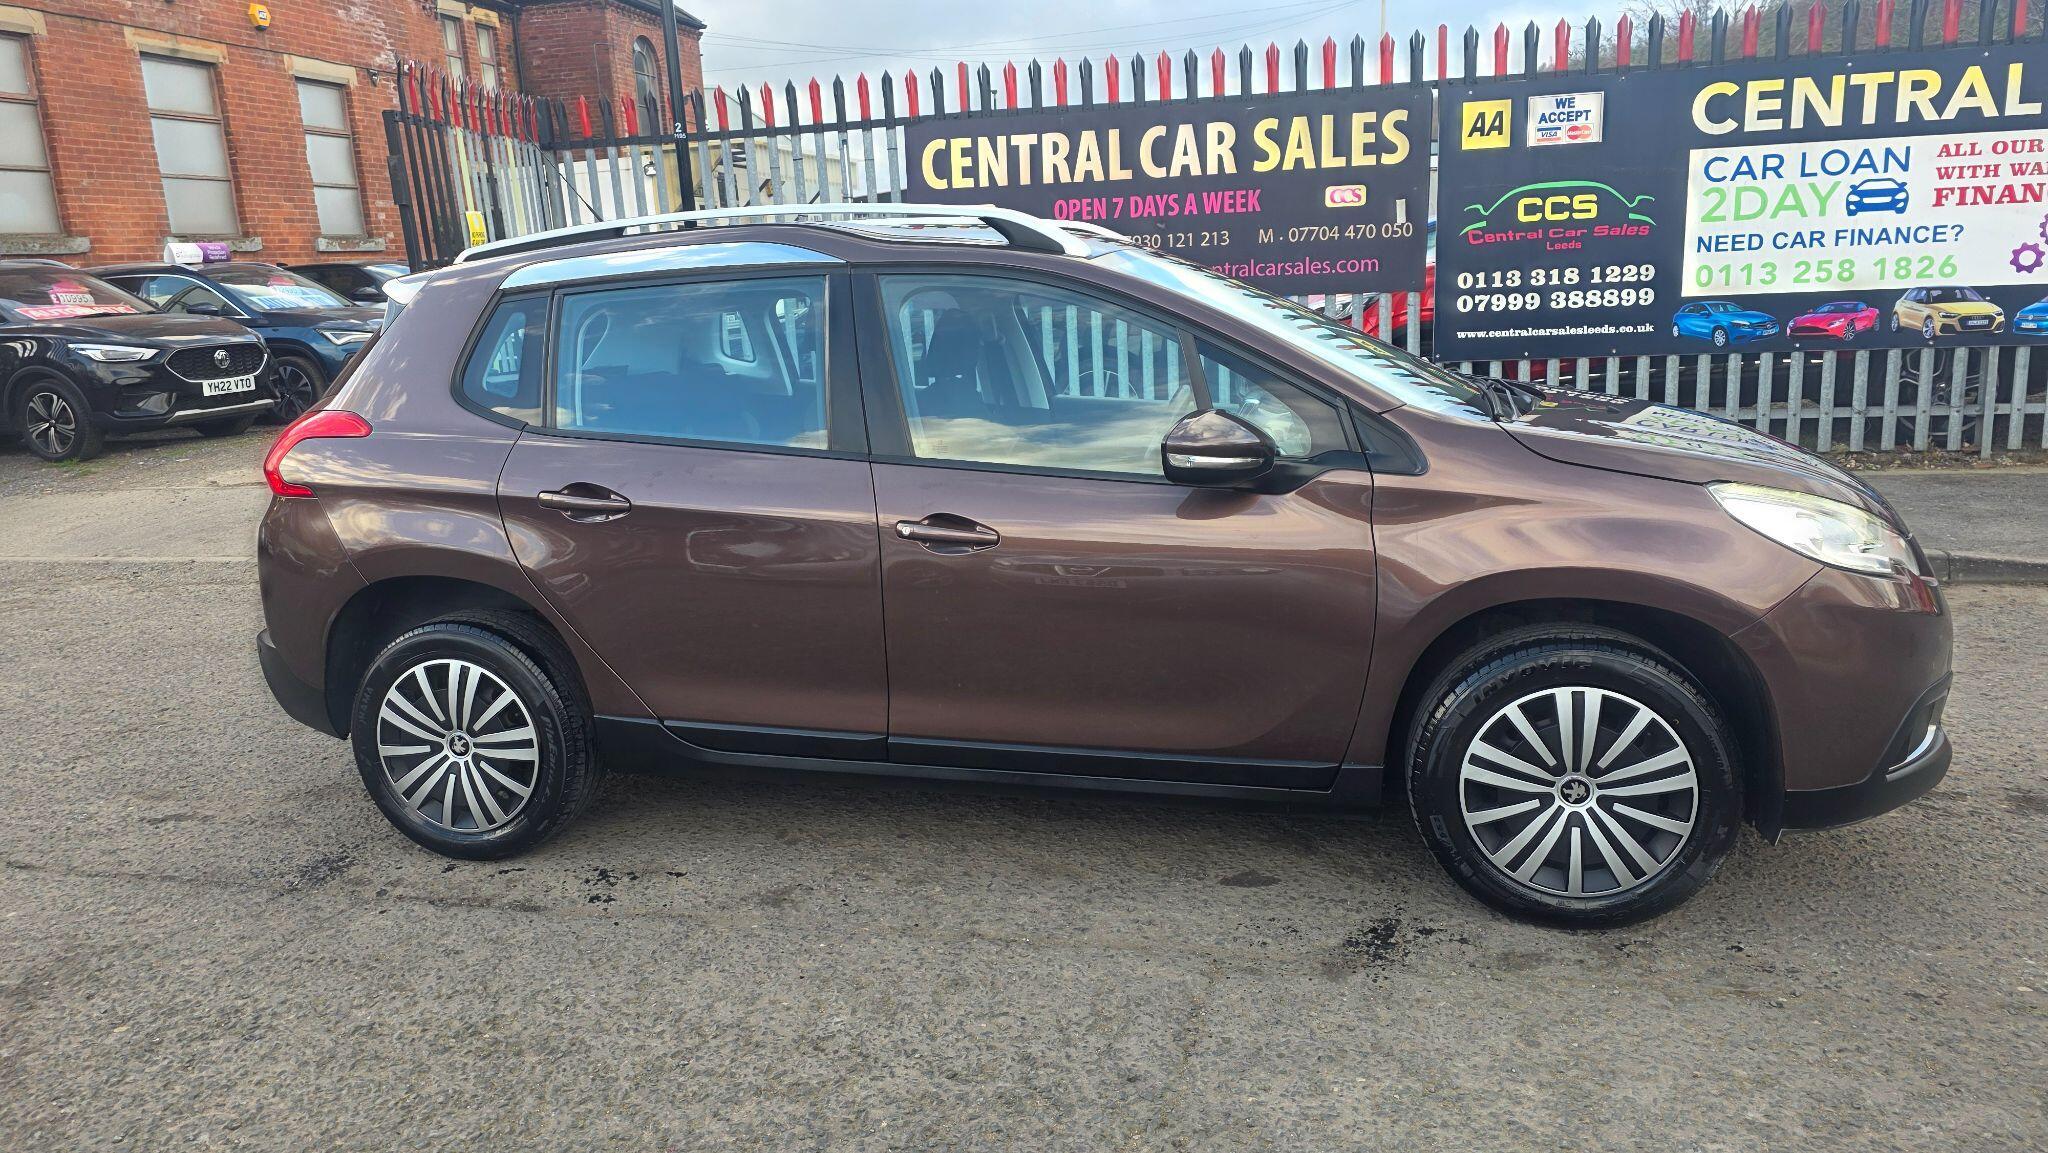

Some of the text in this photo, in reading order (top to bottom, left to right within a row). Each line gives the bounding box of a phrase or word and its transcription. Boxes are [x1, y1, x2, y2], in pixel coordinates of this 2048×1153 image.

[1555, 97, 1576, 109] WE
[1692, 63, 2042, 135] CENTRAL
[674, 122, 682, 132] 2
[1467, 111, 1504, 137] AA
[1538, 110, 1591, 124] ACCEPT
[922, 109, 1410, 189] CENTRAL CAR SALES
[1937, 139, 2045, 157] ALL OUR
[1704, 146, 1911, 183] CAR LOAN
[1936, 161, 2048, 180] WITH WA
[1054, 189, 1261, 221] OPEN 7 DAYS A WEEK
[1517, 194, 1598, 222] CCS
[1701, 181, 1842, 223] 2DAY
[1168, 233, 1193, 248] 121
[1200, 231, 1230, 247] 213
[1259, 228, 1274, 244] M
[1288, 225, 1340, 243] 07704
[1345, 223, 1376, 240] 470
[1382, 222, 1413, 238] 050
[1468, 223, 1650, 245] Central Car Sales
[1546, 241, 1582, 250] Leeds
[1697, 224, 1965, 253] NEED CAR FINANCE?
[1212, 256, 1379, 278] ntralcarsales.com
[1457, 264, 1656, 289] 0113 318 1229
[1695, 255, 1958, 287] 0113 258 1826
[1457, 288, 1655, 312] 07999 388899
[1457, 323, 1655, 338] www.centralcarsalesleeds.co.uk
[208, 378, 251, 392] YH22 VTO
